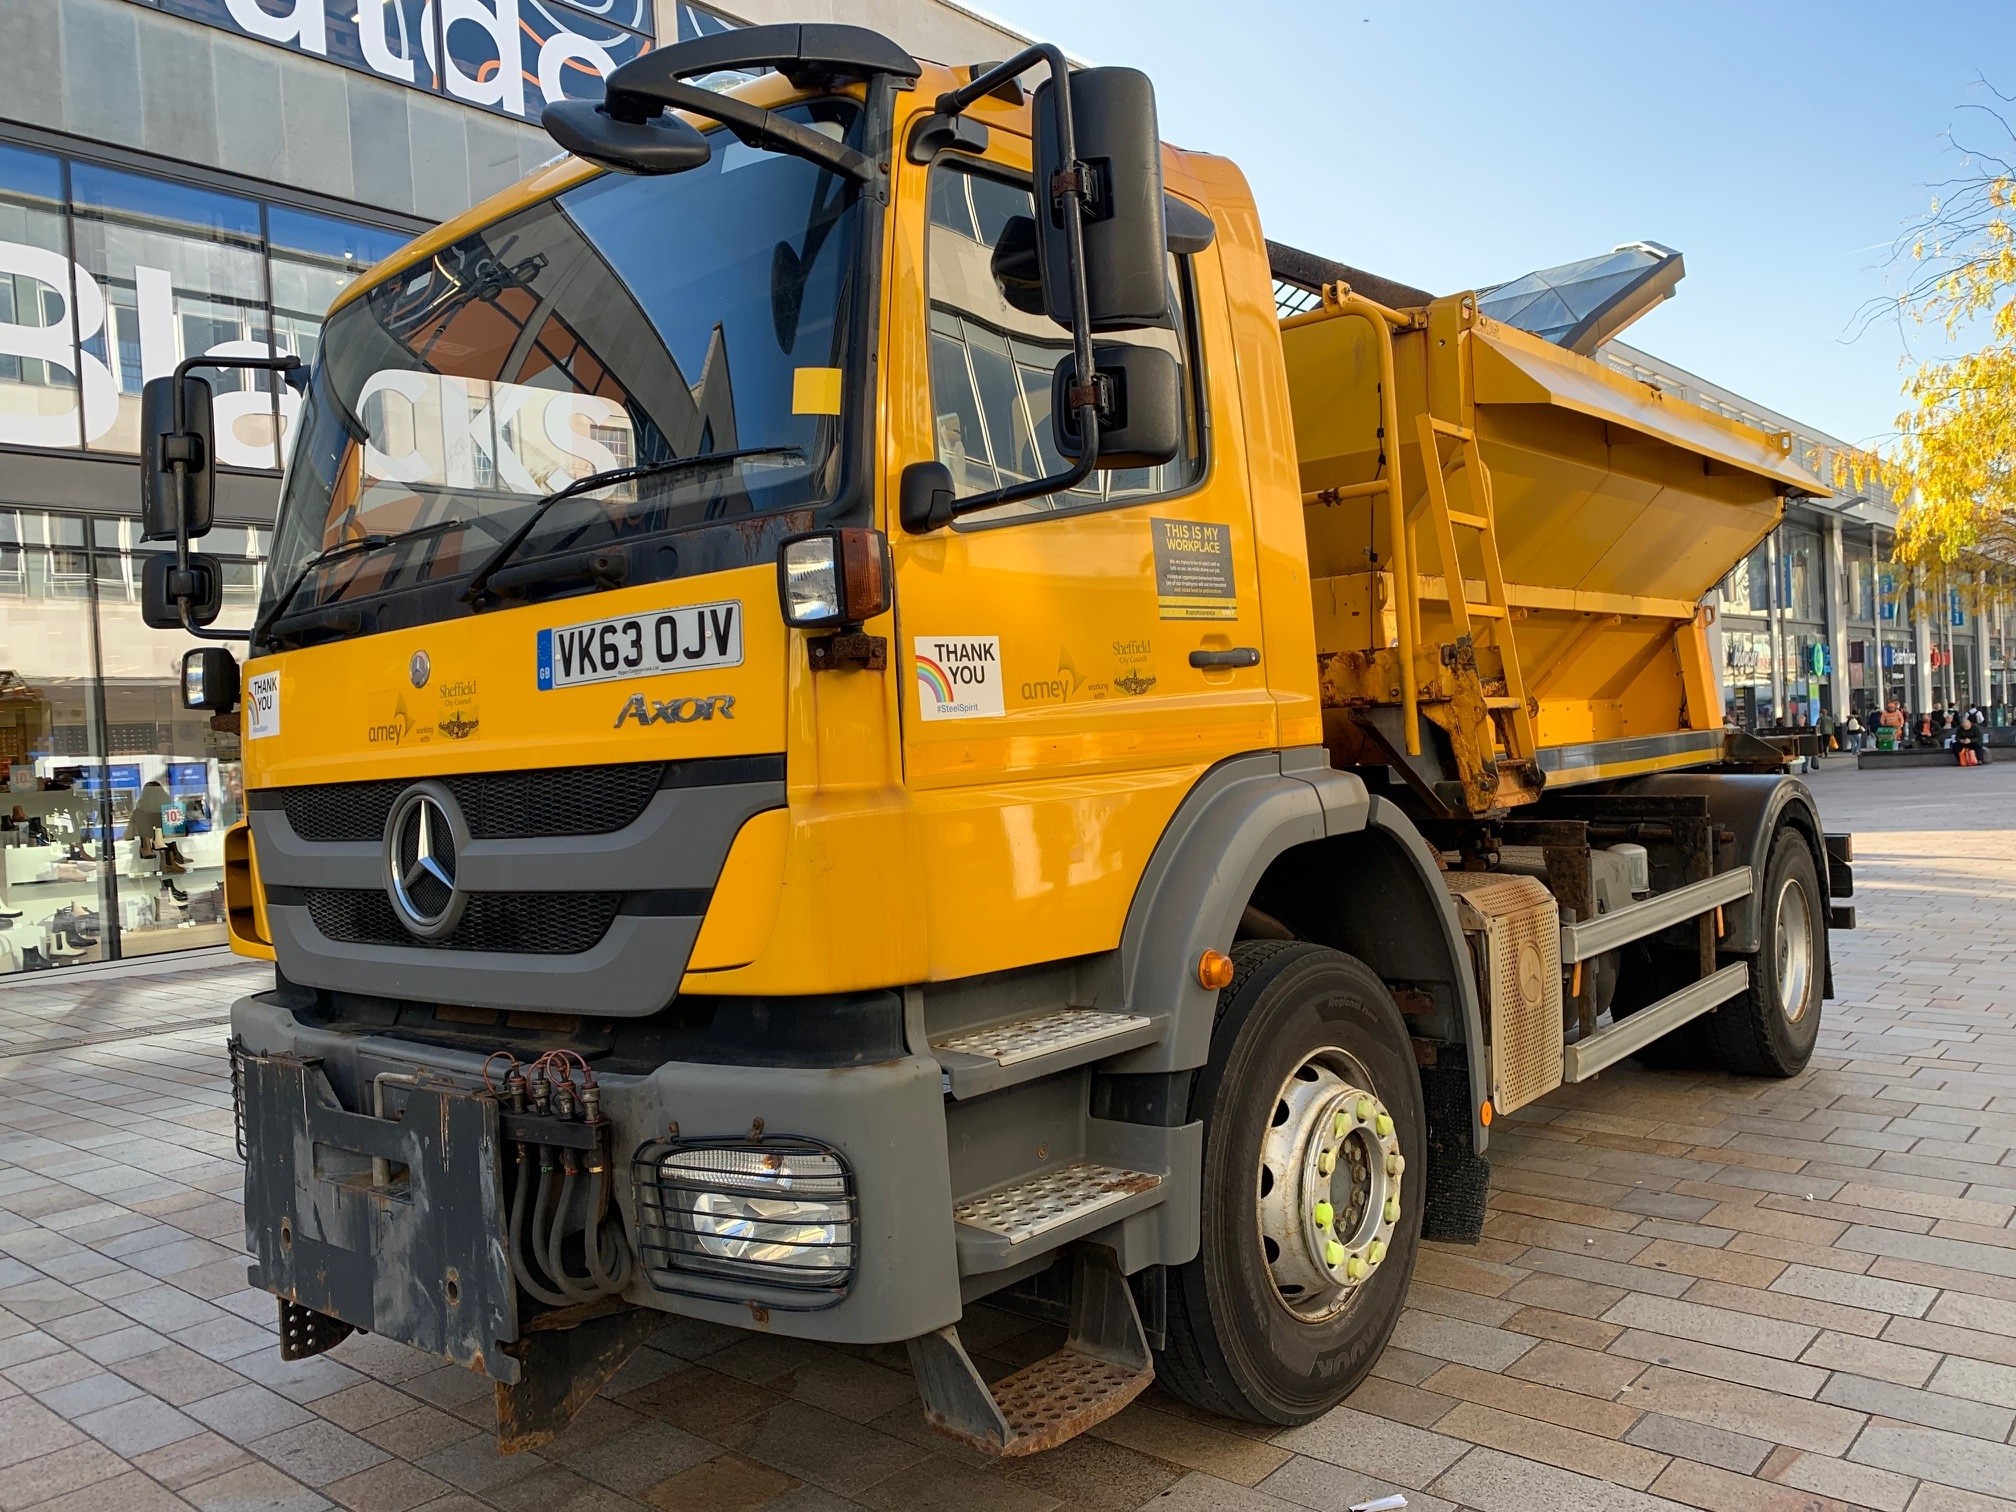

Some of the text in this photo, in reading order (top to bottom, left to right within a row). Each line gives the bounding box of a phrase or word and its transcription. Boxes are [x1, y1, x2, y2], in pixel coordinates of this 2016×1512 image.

[1164, 523, 1219, 541] THIS IS MY
[1166, 538, 1221, 554] WORKPLACE
[558, 607, 734, 678] VK63 OJV
[1112, 640, 1151, 656] Sheffield
[934, 643, 995, 662] THANK
[1119, 655, 1147, 665] City Council
[539, 667, 551, 679] GB
[948, 665, 985, 685] YOU
[254, 677, 277, 695] THANK
[440, 680, 476, 699] Sheffield
[1021, 680, 1069, 703] amey
[1088, 682, 1109, 692] working
[257, 695, 272, 711] YOU
[445, 698, 471, 707] City Council
[1093, 692, 1105, 700] with
[937, 703, 978, 713] #SteelSpirit
[368, 724, 402, 746] amey
[416, 726, 434, 735] working
[1328, 997, 1362, 1010] Regional
